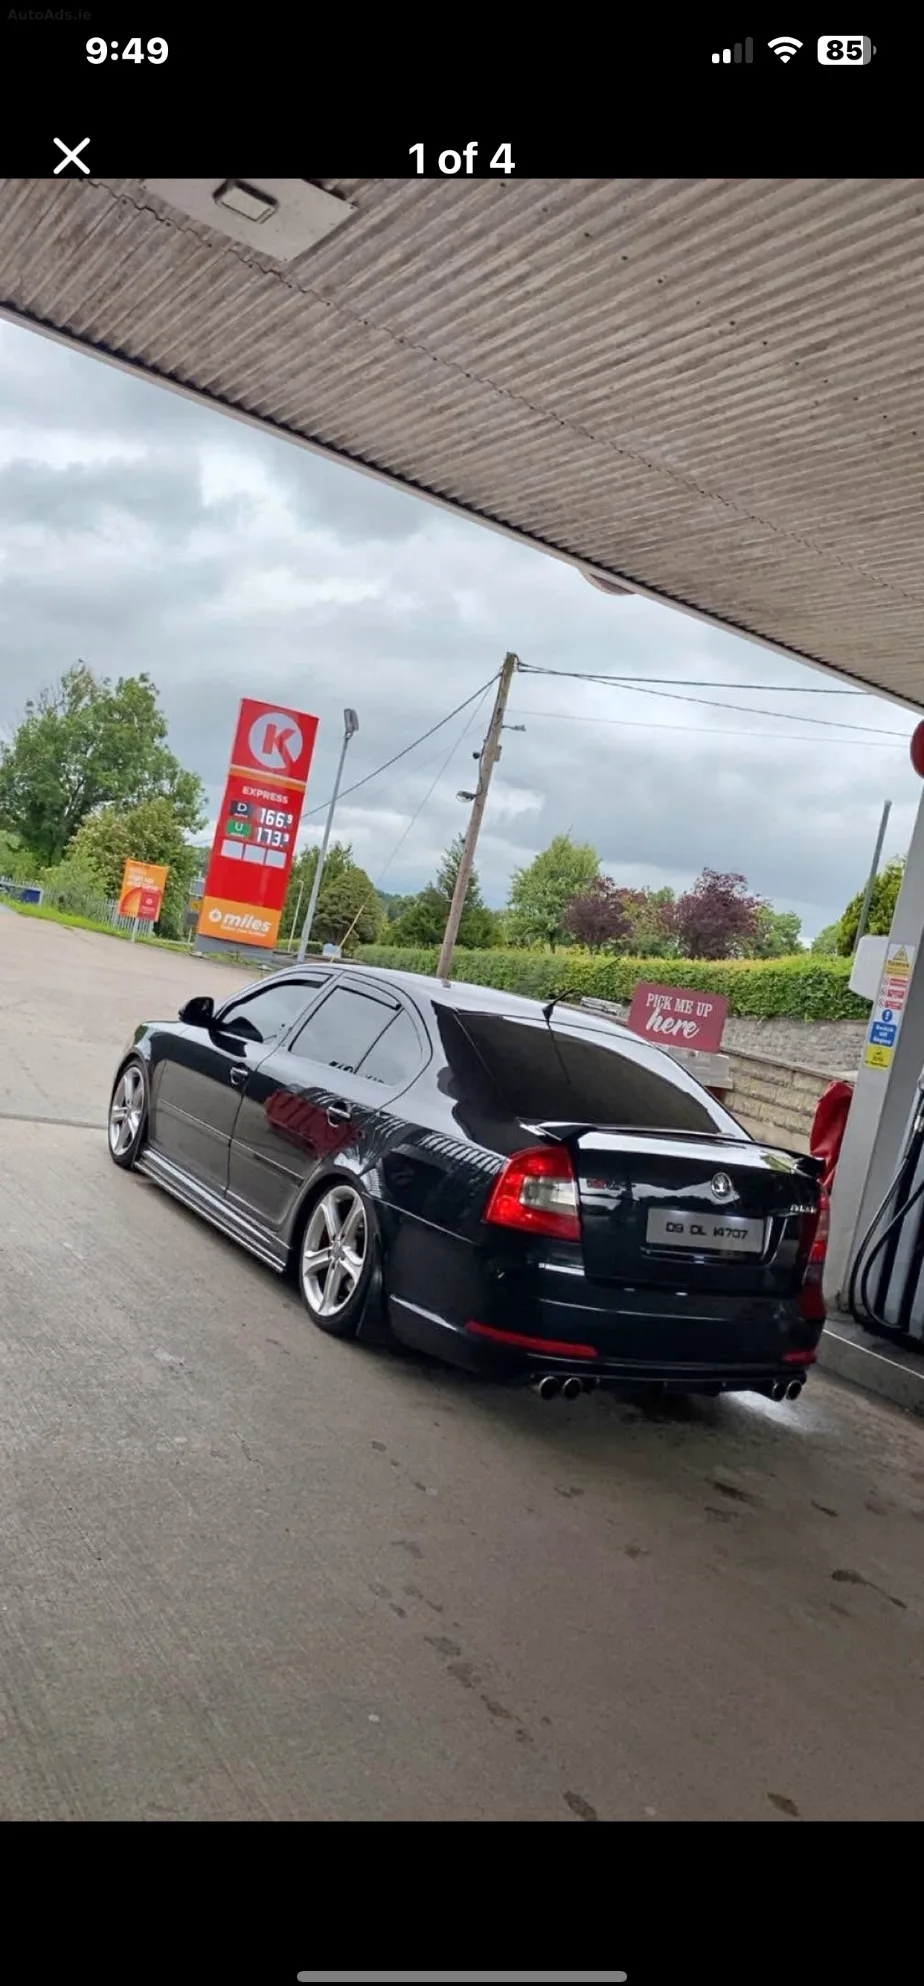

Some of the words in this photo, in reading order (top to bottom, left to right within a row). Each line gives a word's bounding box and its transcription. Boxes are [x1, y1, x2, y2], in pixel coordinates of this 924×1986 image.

[262, 723, 296, 768] K
[242, 785, 289, 804] EXPRESS
[237, 802, 248, 812] D
[235, 822, 243, 832] U
[223, 912, 272, 933] miles
[646, 993, 673, 1011] PICK
[674, 998, 694, 1015] ME
[696, 1001, 713, 1018] UP
[645, 1007, 700, 1039] here
[690, 1224, 706, 1236] DL
